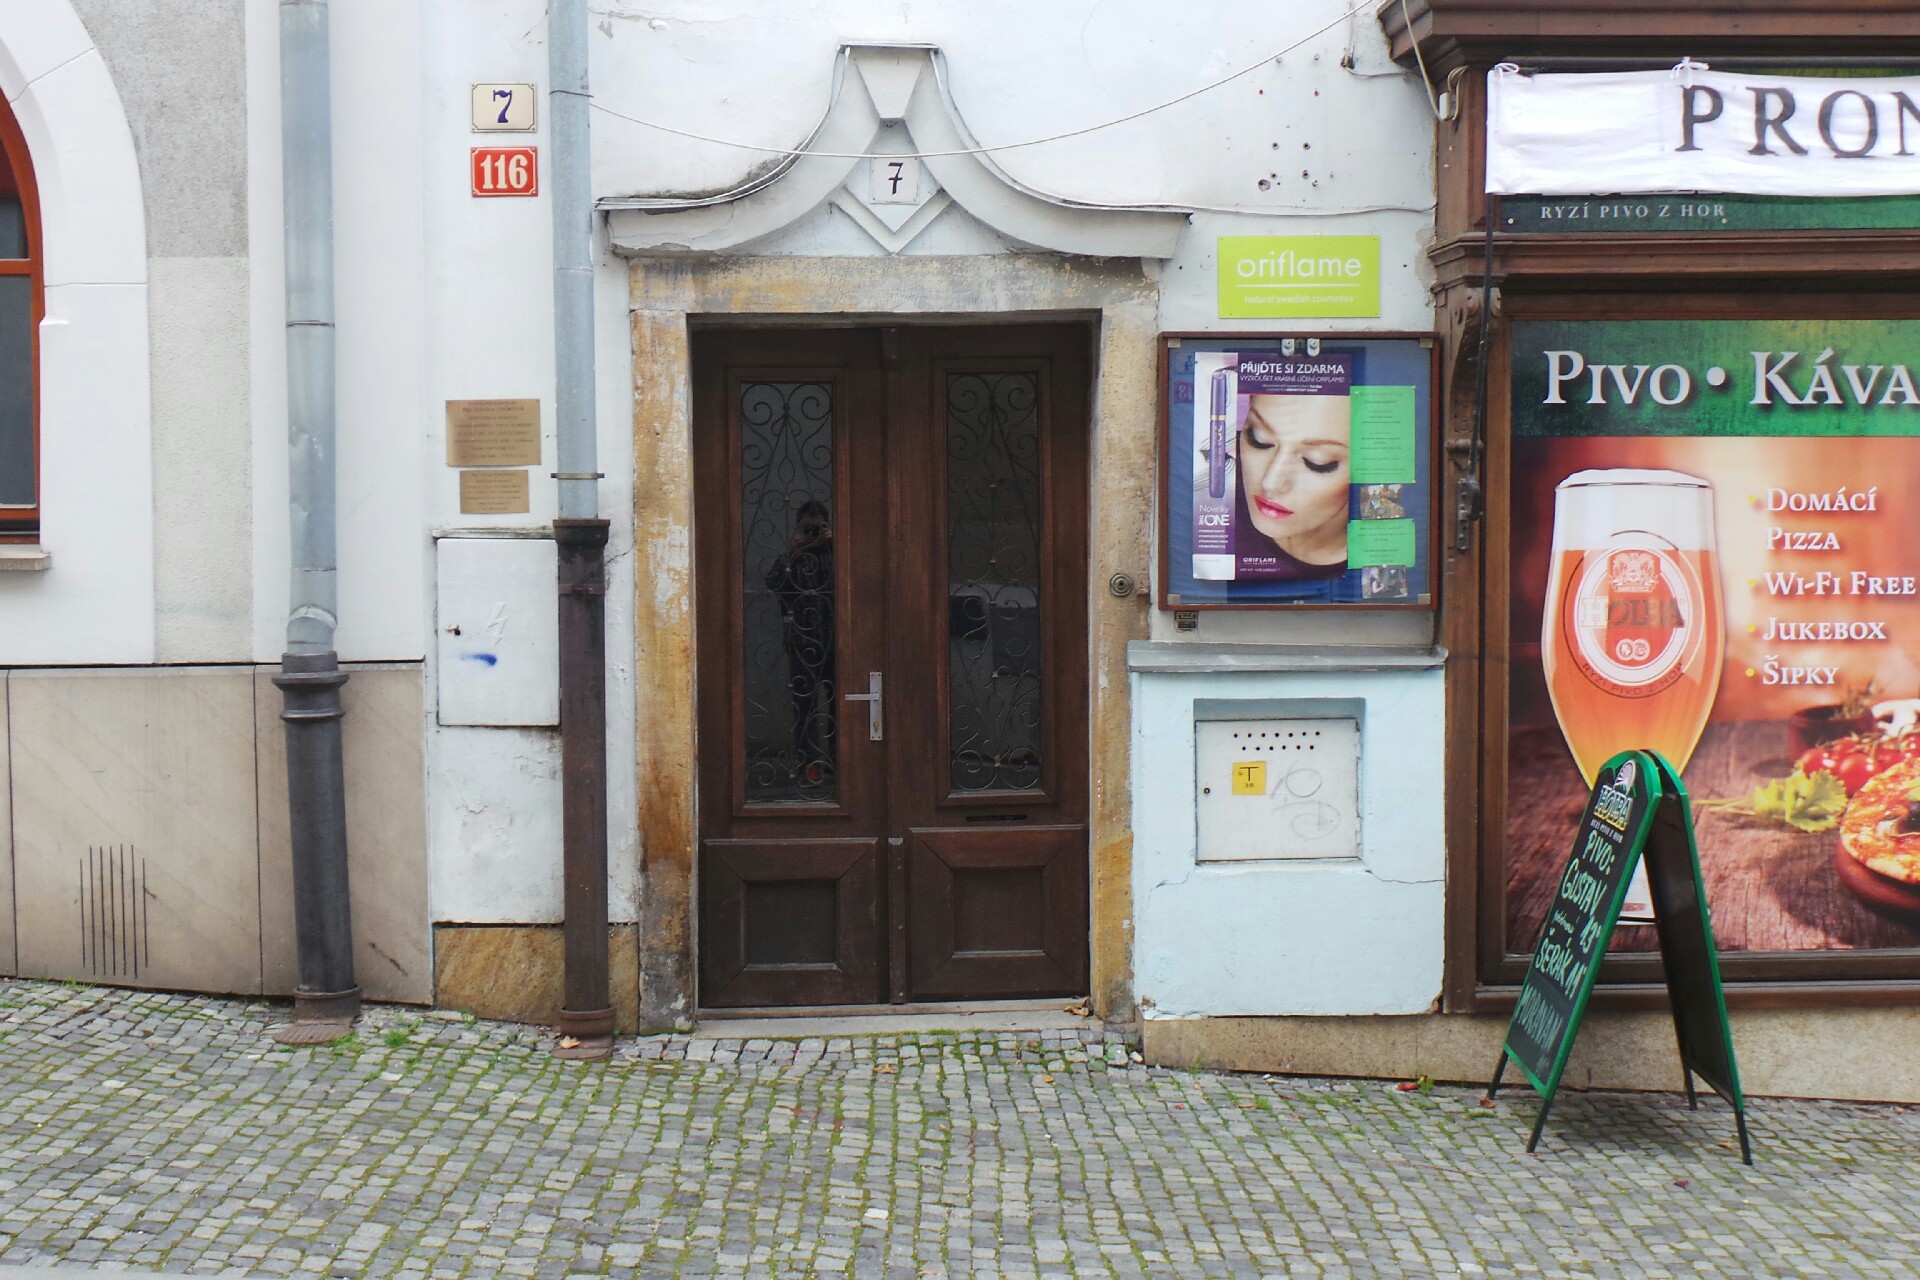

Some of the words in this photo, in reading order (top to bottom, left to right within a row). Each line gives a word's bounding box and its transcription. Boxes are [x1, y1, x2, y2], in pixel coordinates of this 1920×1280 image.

[493, 89, 513, 124] 7
[480, 154, 529, 189] 116
[888, 162, 904, 195] 7
[1540, 201, 1590, 219] RYZÍ
[1599, 205, 1649, 219] PIVO
[1658, 205, 1671, 218] Z
[1680, 204, 1726, 218] HOR
[1236, 250, 1362, 278] oriflame
[1244, 295, 1276, 303] natural
[1277, 295, 1310, 303] swedish
[1311, 295, 1354, 303] cosmetics
[1240, 360, 1283, 376] PŘIJĎTE
[1284, 363, 1294, 374] SI
[1296, 363, 1345, 375] ZDARMA
[1543, 349, 1691, 405] PIVO
[1199, 504, 1229, 513] Novinky
[1766, 486, 1878, 512] DOMÁCÍ
[1204, 514, 1230, 526] ONE
[1766, 527, 1841, 550] PIZZA
[1763, 571, 1841, 595] WI-FI
[1850, 571, 1917, 595] FREE
[1763, 617, 1887, 641] JUKEBOX
[1762, 655, 1839, 685] ŠIPKY
[1593, 784, 1634, 832] HOLBA
[1582, 829, 1615, 876] PIVO:
[1561, 857, 1608, 917] GUSTAV
